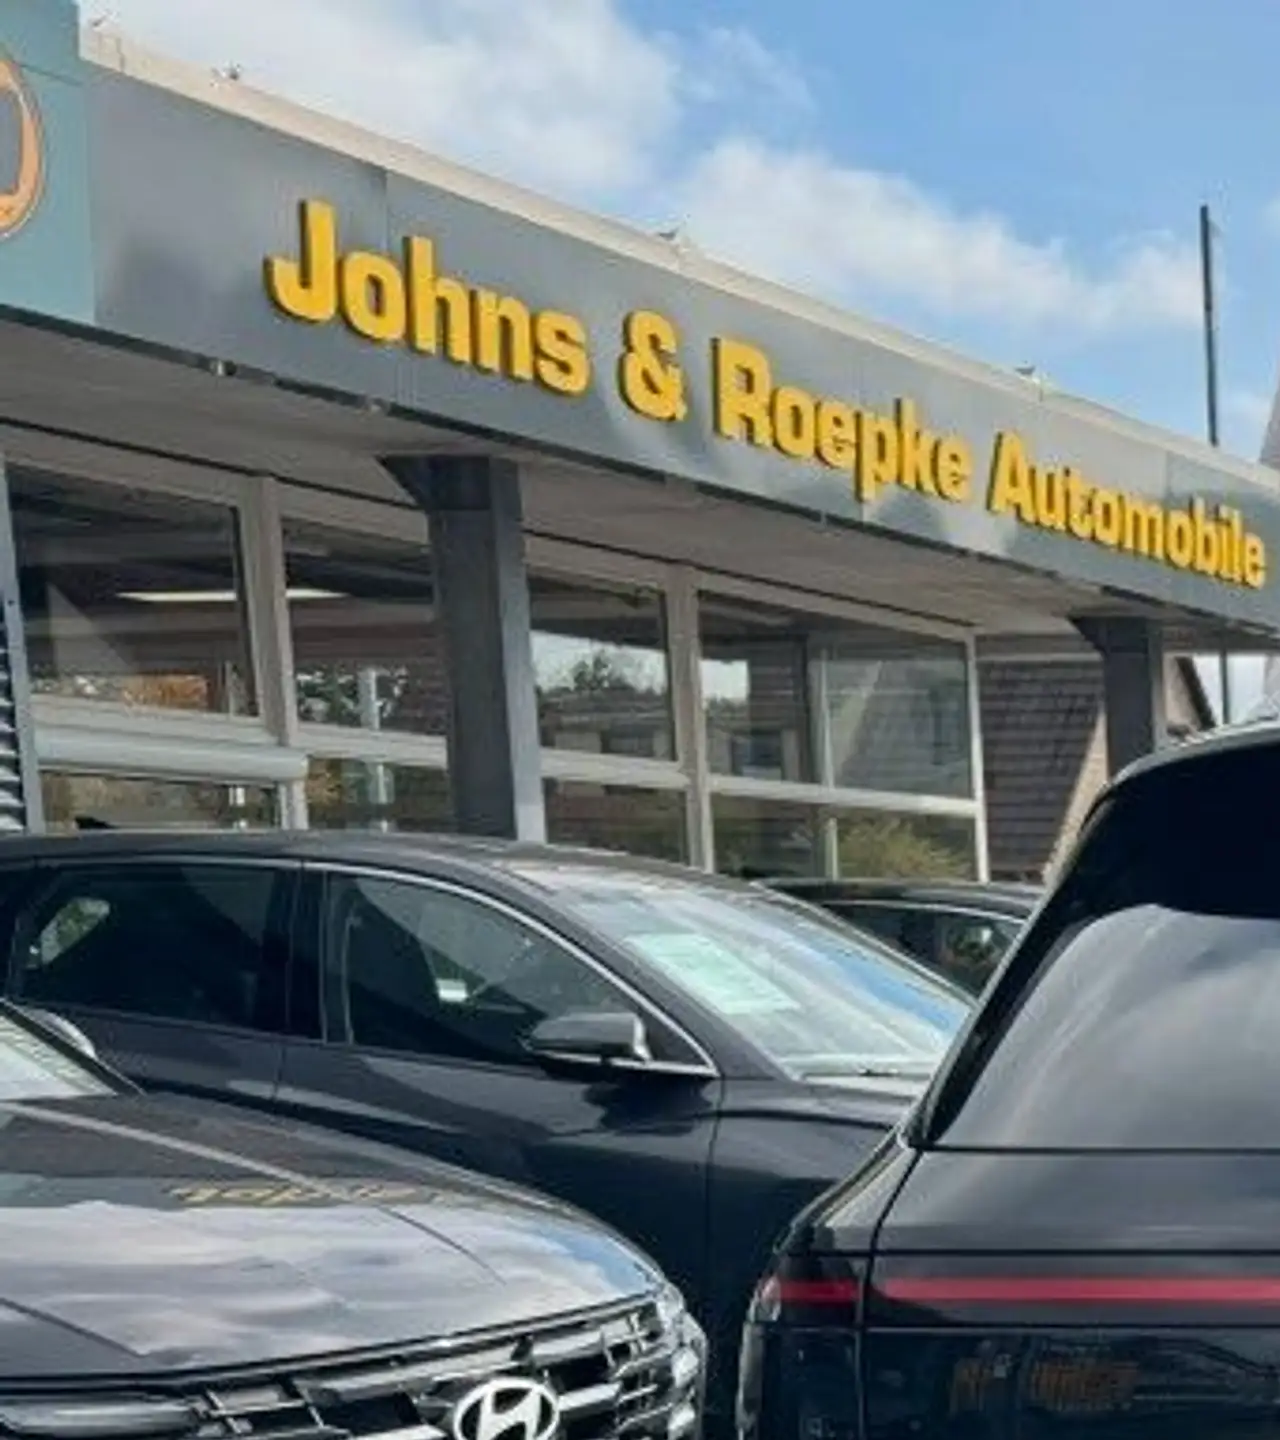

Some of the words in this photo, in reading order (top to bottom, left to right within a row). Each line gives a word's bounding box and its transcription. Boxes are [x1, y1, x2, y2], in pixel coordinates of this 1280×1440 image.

[265, 199, 591, 396] Johns
[620, 308, 686, 422] &
[711, 337, 974, 502] Roepke
[987, 431, 1267, 589] Automobile
